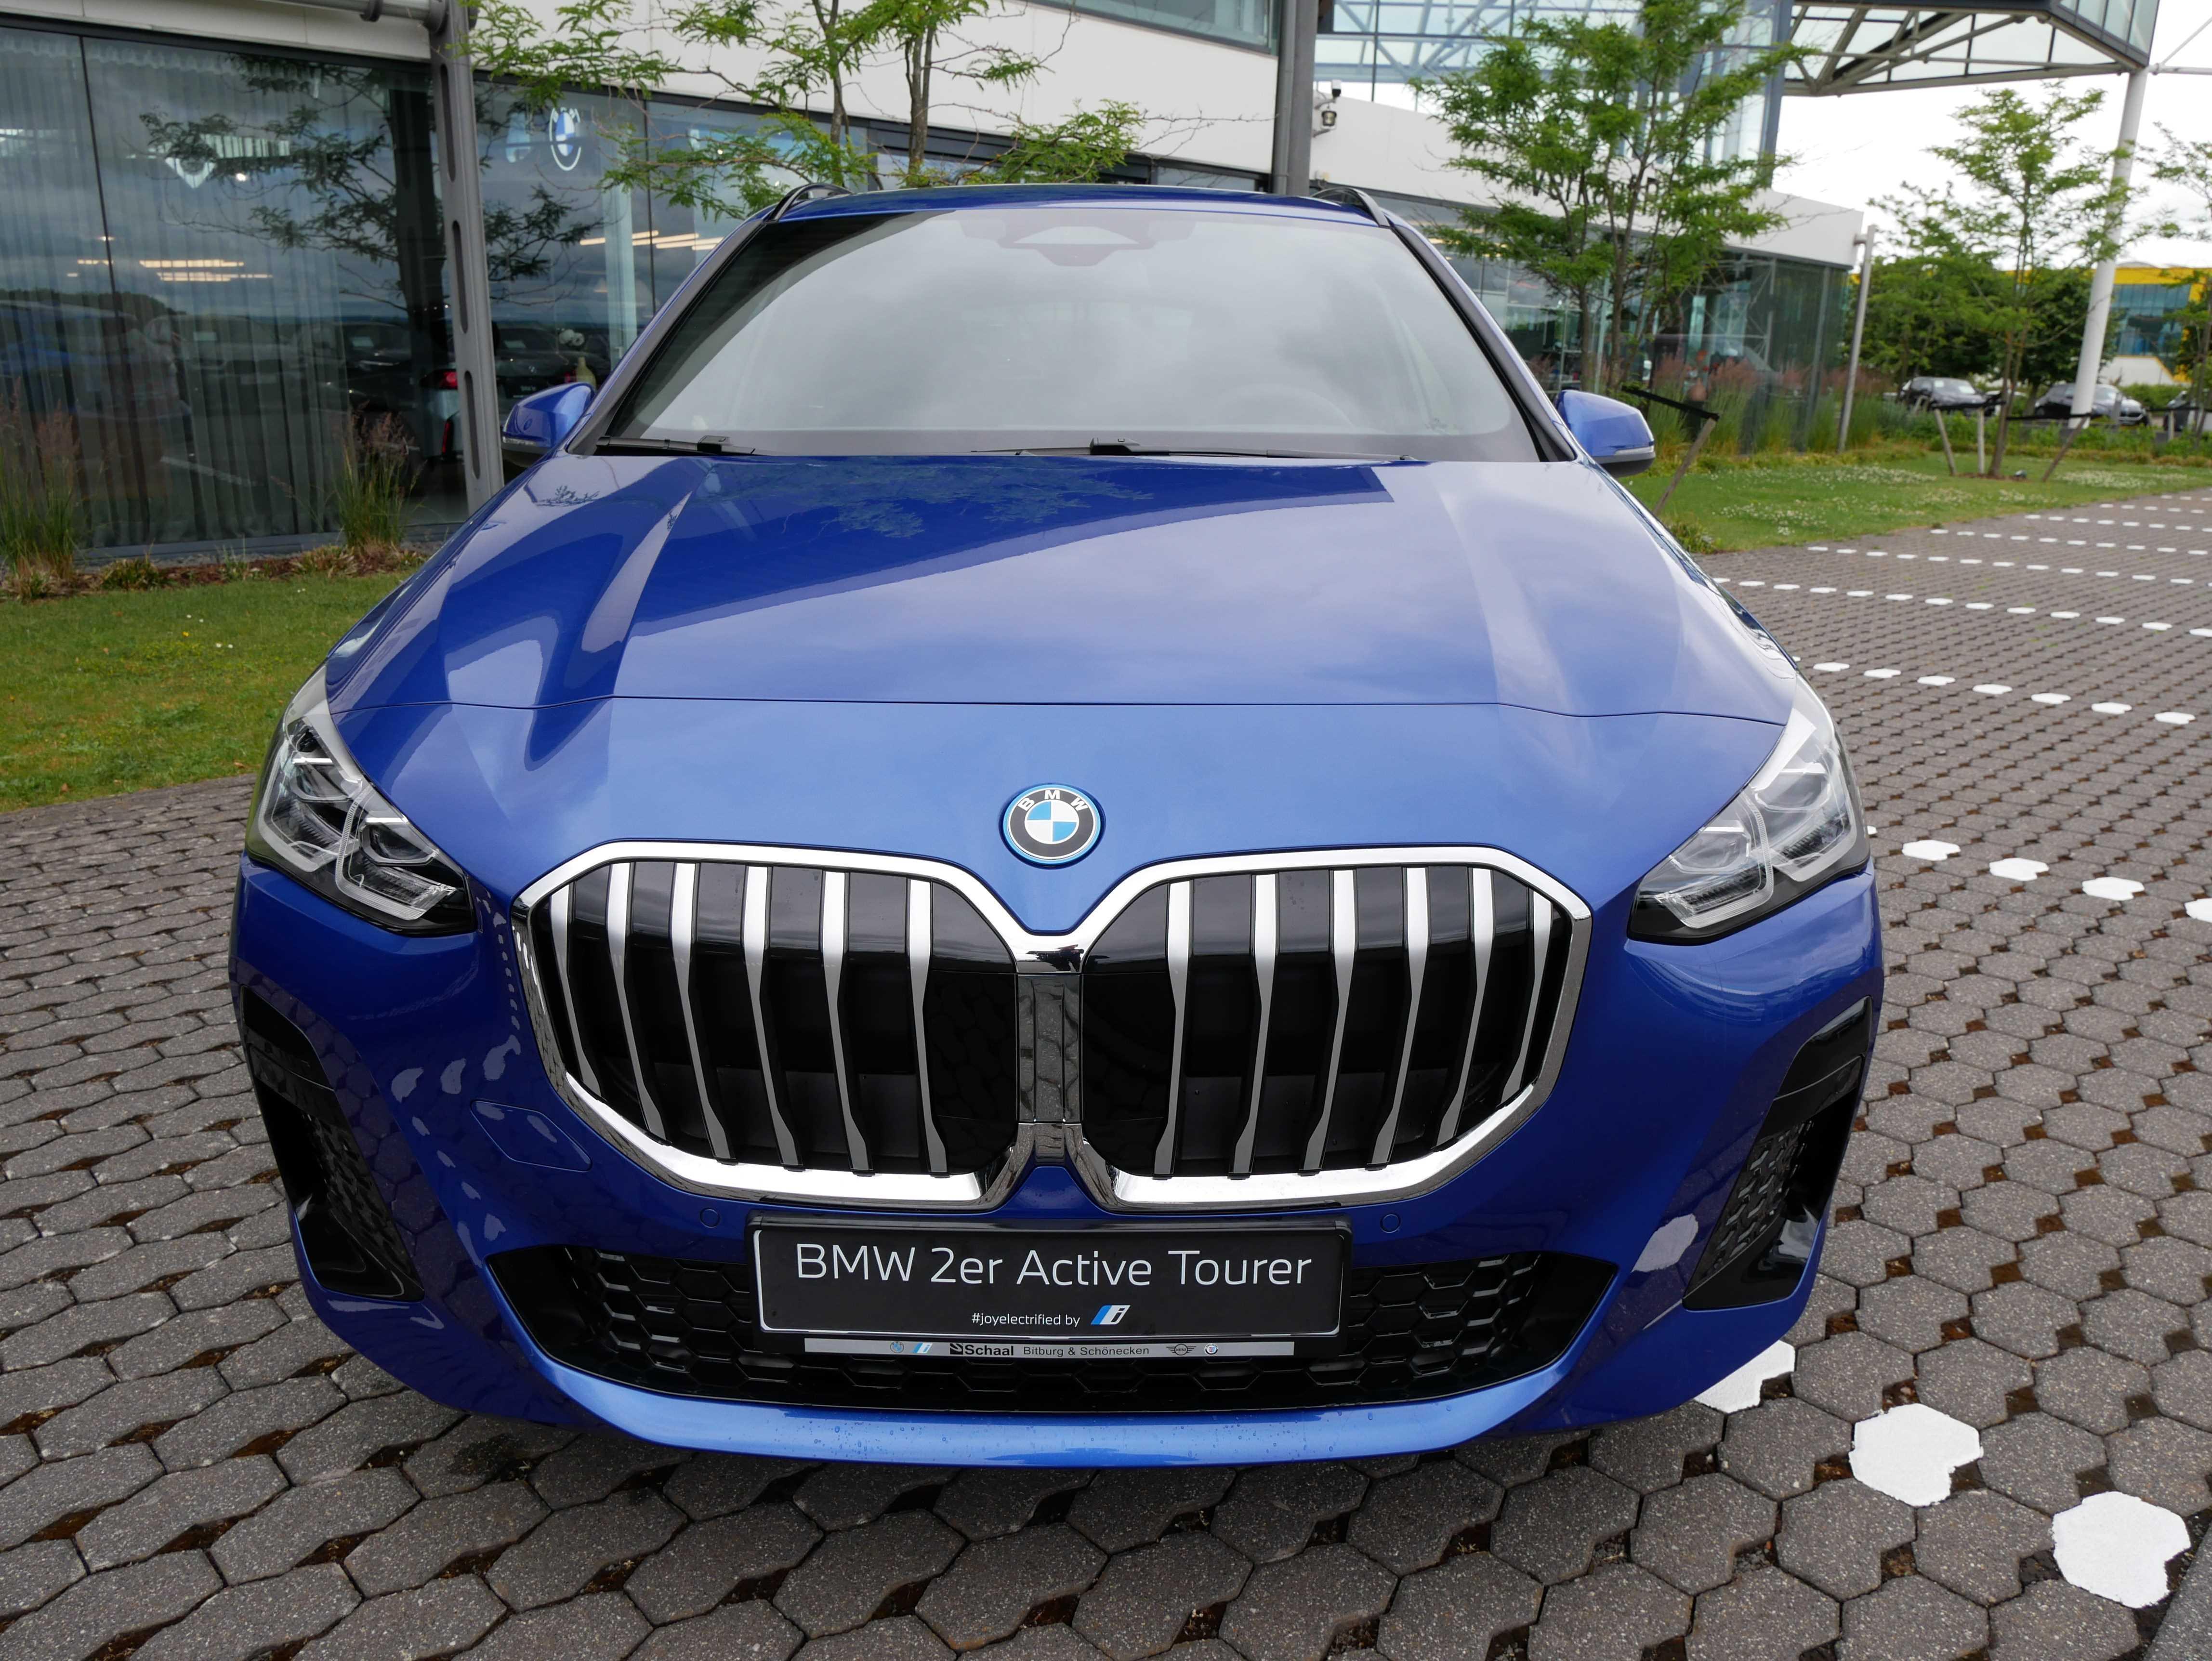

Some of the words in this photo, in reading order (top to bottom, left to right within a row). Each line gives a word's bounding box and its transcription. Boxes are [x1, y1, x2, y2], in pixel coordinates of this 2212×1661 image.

[1017, 790, 1089, 812] BMW
[796, 1243, 916, 1281] BMW
[930, 1247, 1003, 1284] 2er
[1016, 1250, 1152, 1285] Active
[1167, 1250, 1313, 1285] Tourer
[971, 1312, 1061, 1326] #joyelectrified
[1065, 1314, 1080, 1327] by
[964, 1345, 1014, 1356] Schaal
[1023, 1346, 1064, 1357] Bitburg
[1067, 1347, 1076, 1356] &
[1080, 1346, 1149, 1356] Schönecken
